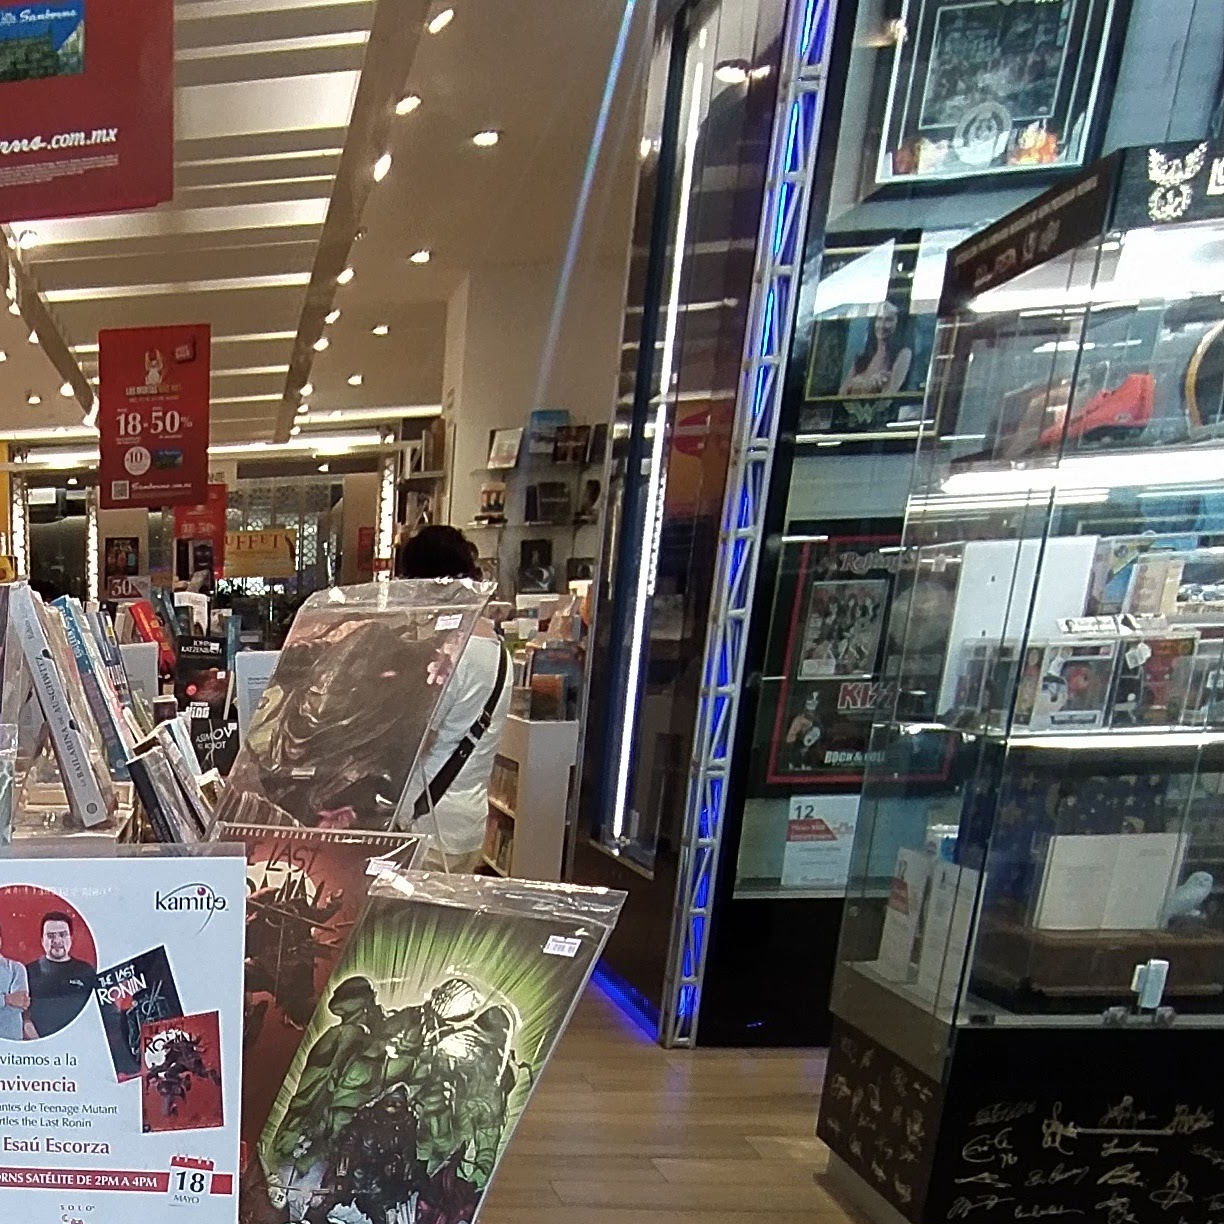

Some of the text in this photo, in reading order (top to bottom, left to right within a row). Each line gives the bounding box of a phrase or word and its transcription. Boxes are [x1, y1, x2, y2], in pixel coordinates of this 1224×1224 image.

[34, 654, 61, 714] AUSCHWITZ
[60, 727, 87, 779] BAILARINA
[794, 804, 815, 819] 12
[97, 972, 148, 1007] RONIN
[53, 1056, 62, 1066] a
[65, 1053, 77, 1067] la
[23, 1102, 37, 1113] de
[39, 1103, 80, 1116] Teenage
[81, 1104, 118, 1115] Mutant
[21, 1116, 38, 1127] the
[39, 1117, 60, 1128] Last
[62, 1117, 92, 1128] Ronin
[3, 1136, 40, 1152] Esaú
[46, 1137, 111, 1155] Escorza
[25, 1171, 74, 1185] SATÉLITE
[76, 1174, 92, 1185] DE
[94, 1175, 119, 1187] 2PM
[121, 1176, 130, 1187] A
[131, 1176, 158, 1188] 4PM
[175, 1169, 205, 1194] 18
